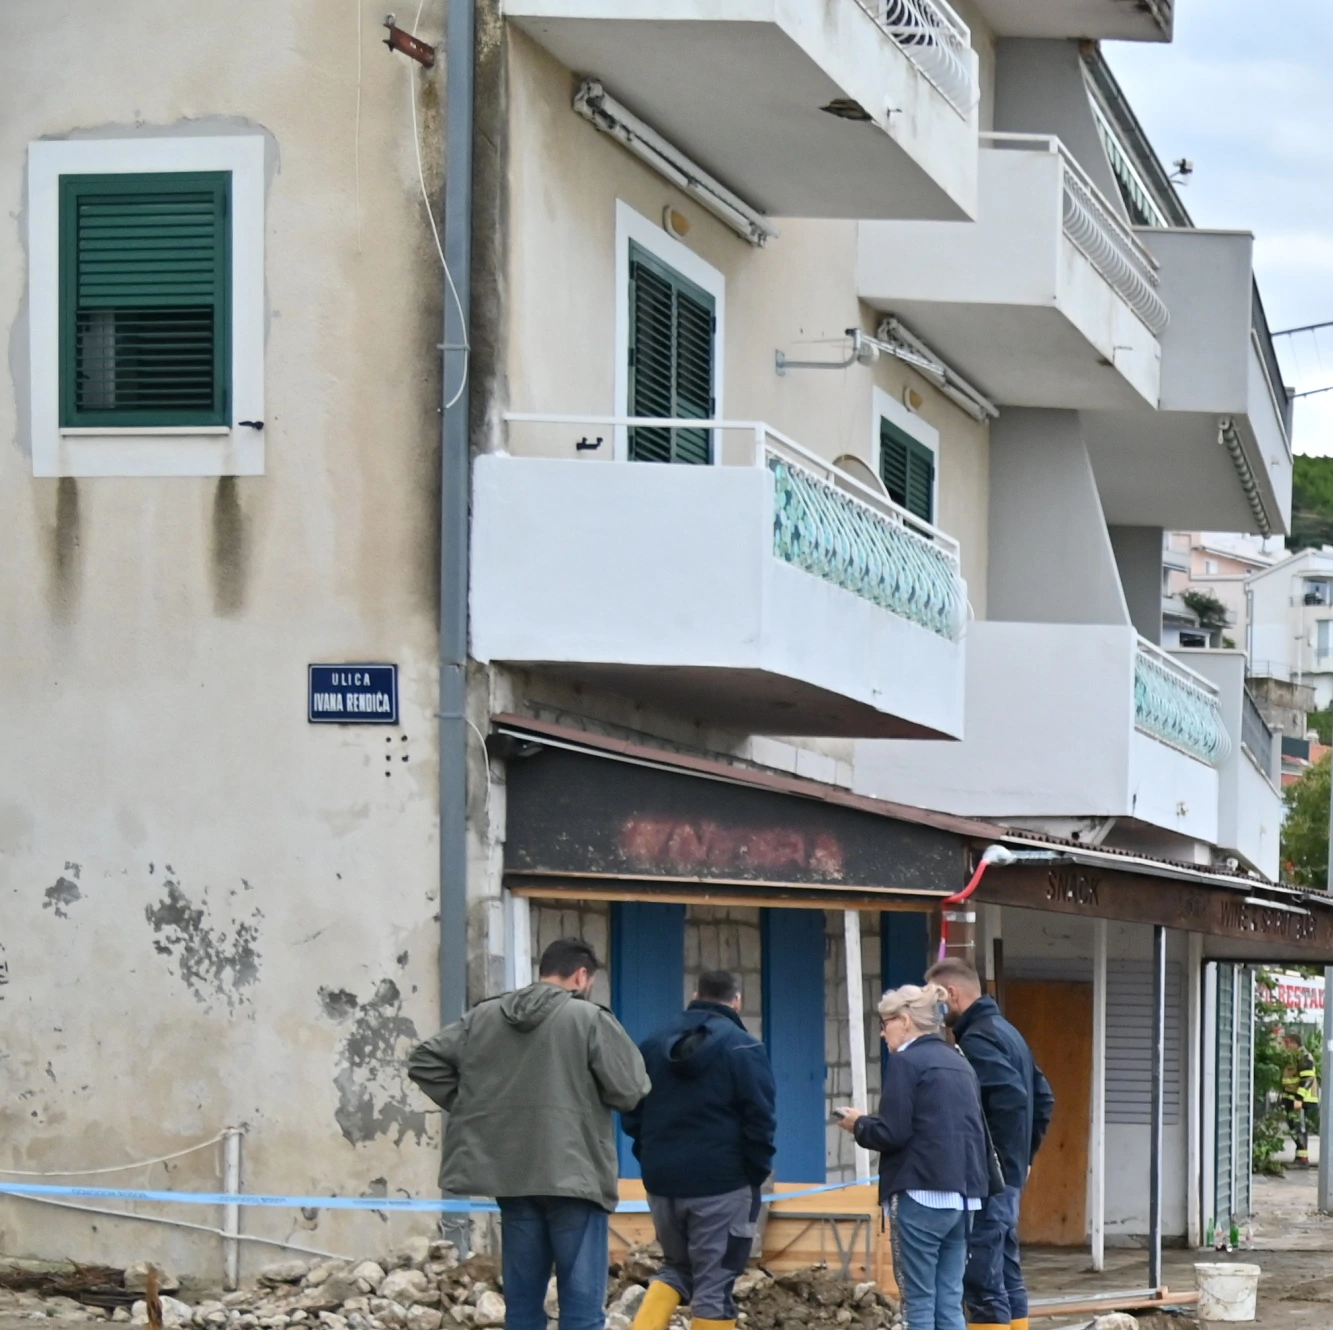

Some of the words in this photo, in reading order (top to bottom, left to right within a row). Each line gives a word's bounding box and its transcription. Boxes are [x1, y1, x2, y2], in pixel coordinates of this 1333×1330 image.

[331, 672, 371, 686] ULICA
[313, 692, 344, 712] IVANA
[1046, 869, 1102, 906] SNACK
